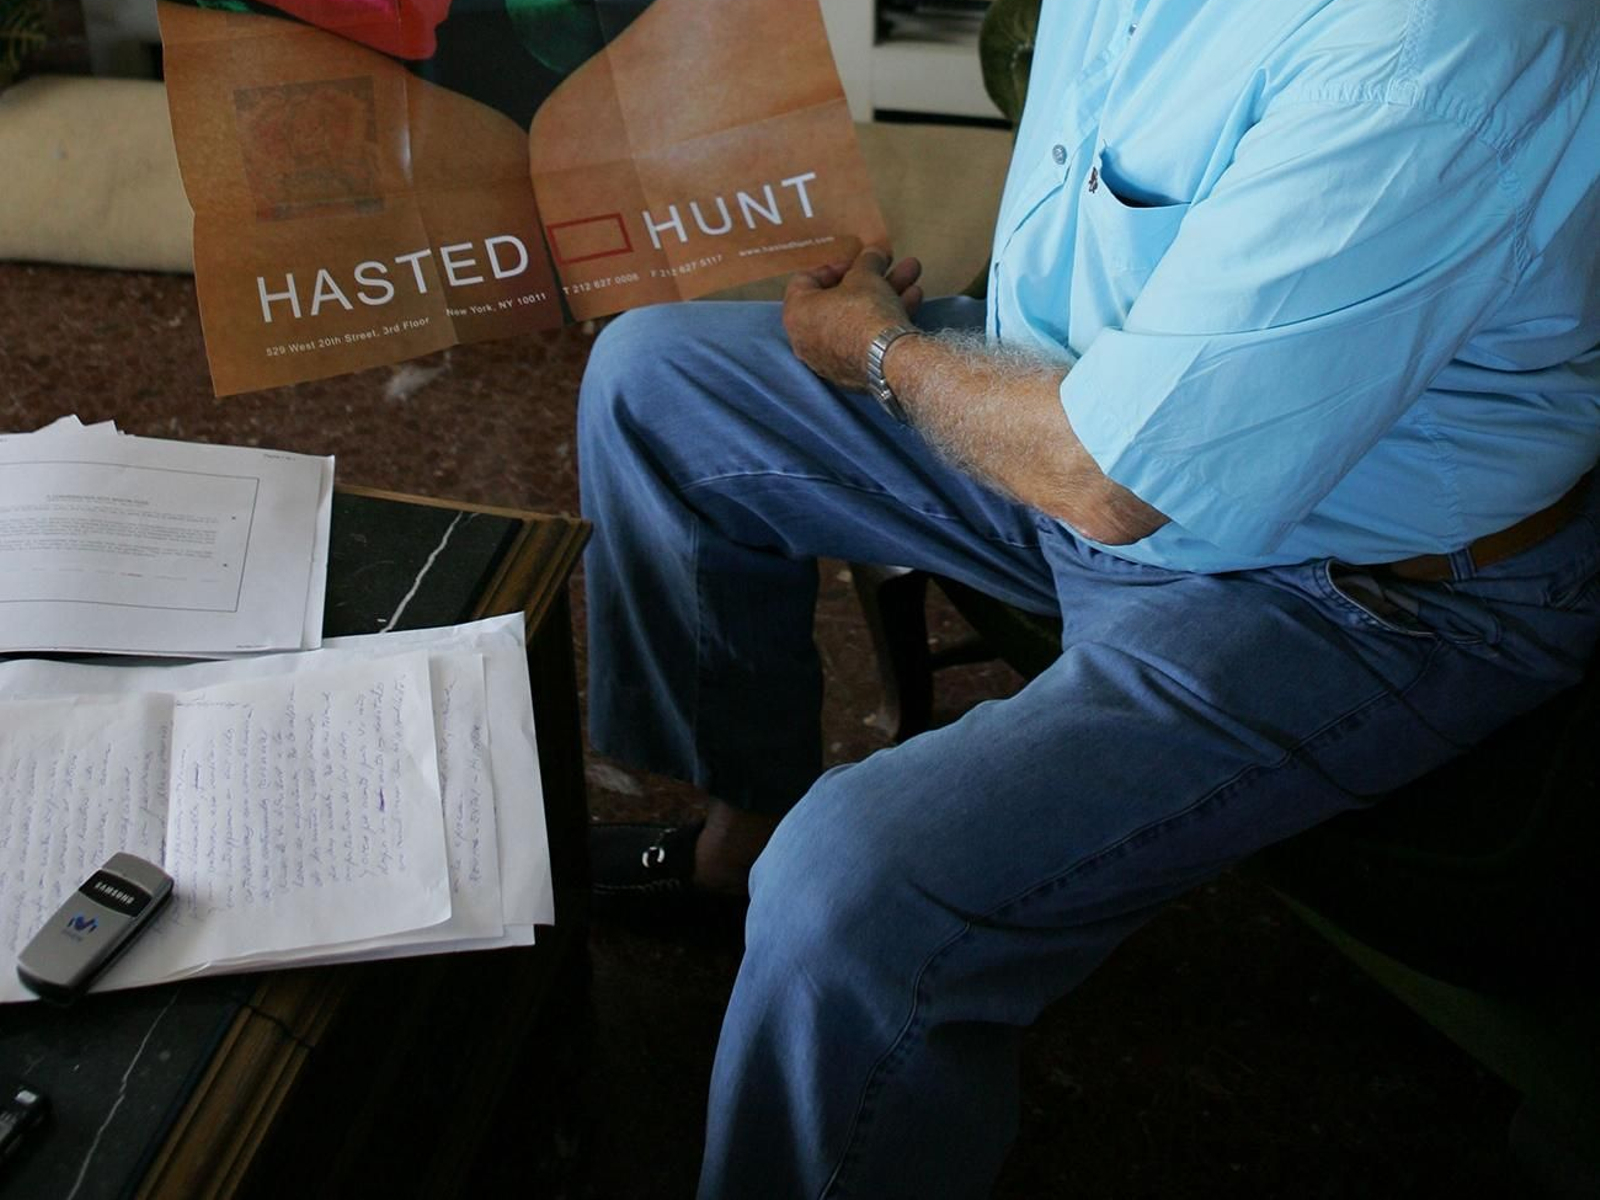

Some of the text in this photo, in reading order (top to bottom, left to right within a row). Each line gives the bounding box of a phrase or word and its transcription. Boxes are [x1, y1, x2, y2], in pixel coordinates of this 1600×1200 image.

[256, 171, 817, 324] HASTED HUNT
[572, 281, 591, 294] 212
[265, 346, 286, 358] 529
[288, 340, 316, 354] West
[318, 334, 343, 349] 20th
[383, 324, 401, 337] 3rd
[402, 316, 430, 330] Floor
[445, 307, 468, 317] New
[498, 298, 513, 310] NY
[516, 292, 547, 306] 10011
[94, 881, 136, 906] SAMSUNG
